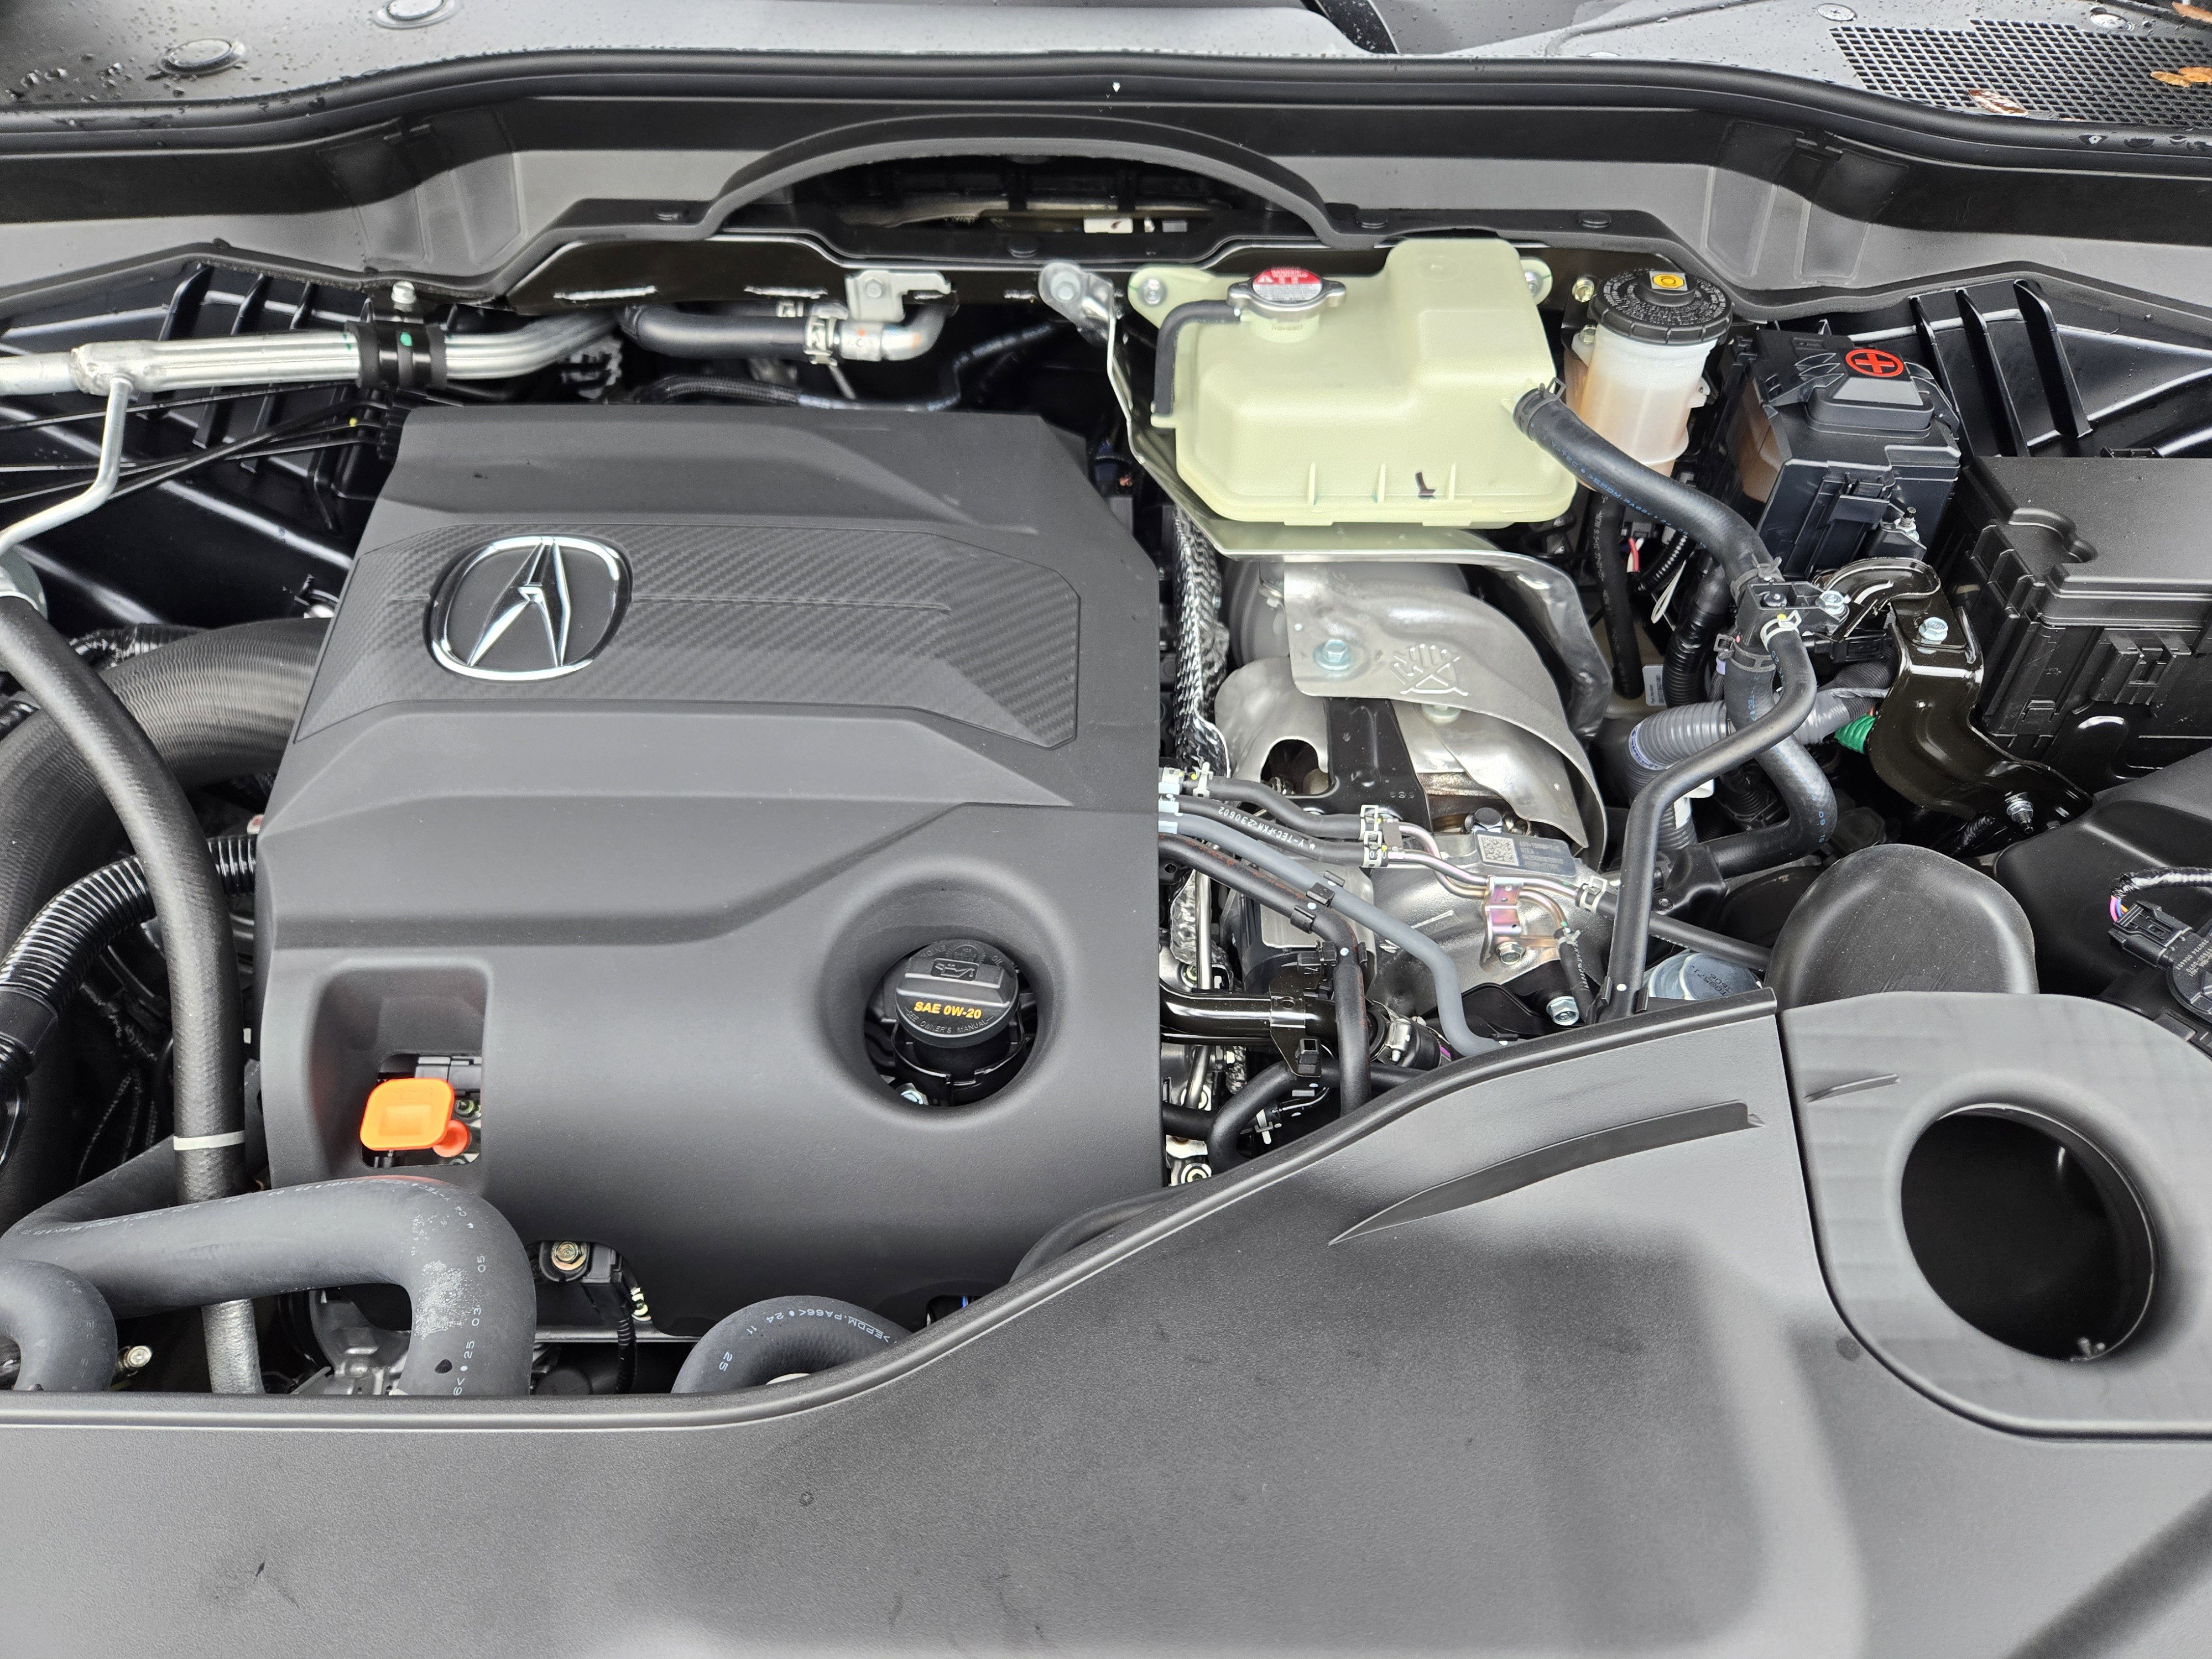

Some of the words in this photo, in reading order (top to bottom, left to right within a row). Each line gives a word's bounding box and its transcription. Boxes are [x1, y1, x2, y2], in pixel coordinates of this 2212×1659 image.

[914, 1001, 942, 1014] SAE
[943, 1005, 982, 1019] 0W-20
[920, 1021, 952, 1034] OWNER'S
[766, 1311, 784, 1323] 24
[463, 1340, 475, 1359] 25
[472, 1306, 482, 1327] 03
[745, 1326, 758, 1335] 11
[718, 1351, 733, 1372] 25
